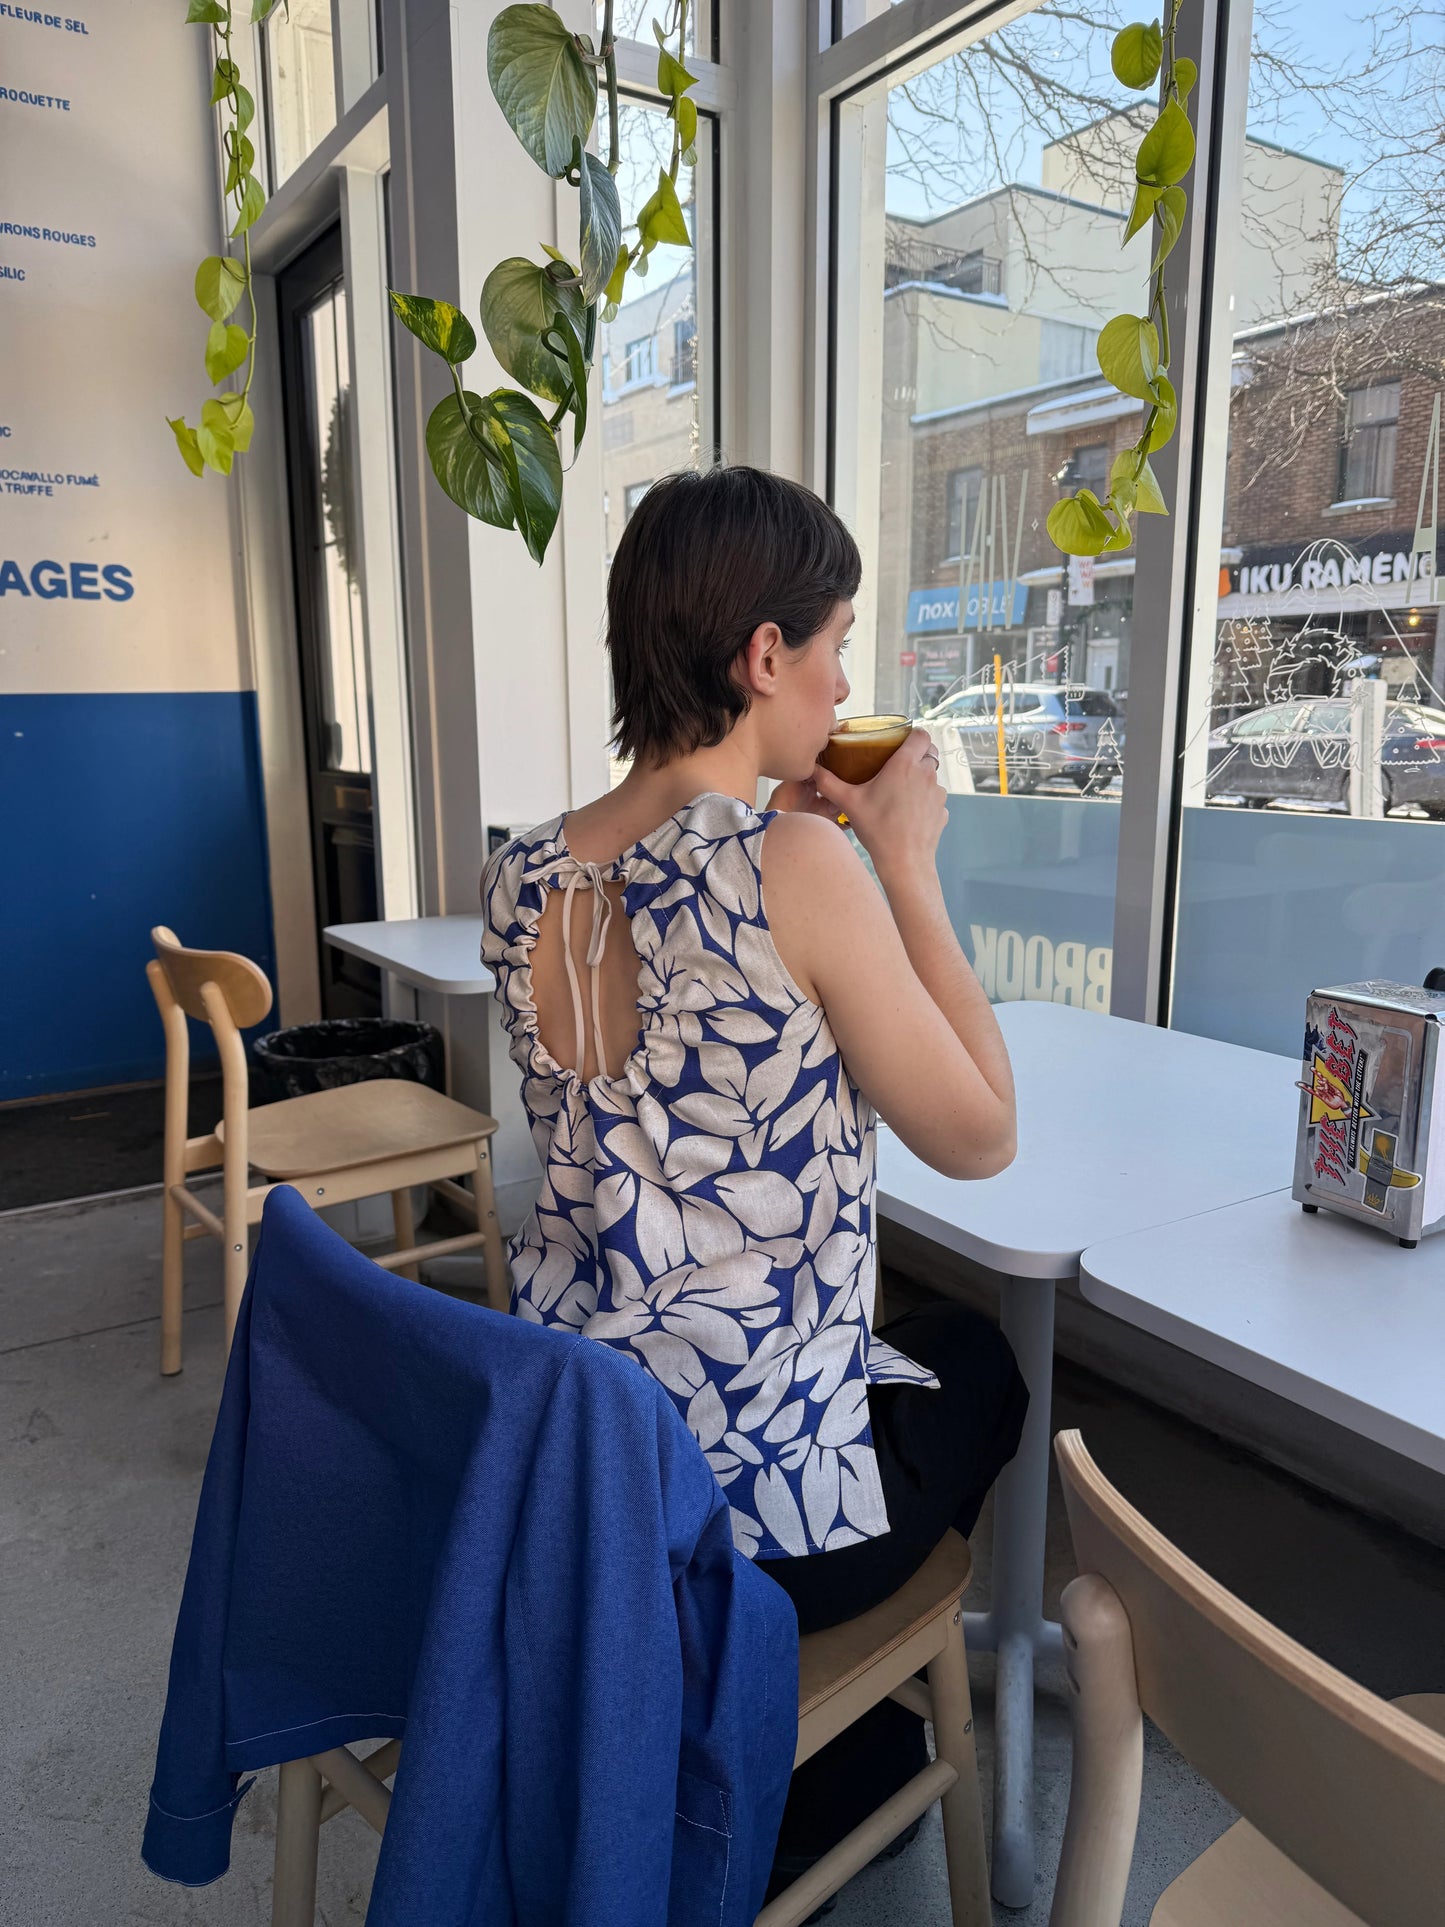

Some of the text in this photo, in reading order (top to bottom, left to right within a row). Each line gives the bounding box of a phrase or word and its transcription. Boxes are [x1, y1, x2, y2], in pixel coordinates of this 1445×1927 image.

[0, 3, 89, 35] FLEUR DE SEL
[0, 86, 71, 111] ROQUETTE
[42, 228, 97, 248] ROUGES
[5, 482, 54, 497] TRUFFE
[66, 474, 100, 487] FUMÉ
[1239, 551, 1418, 595] IKU RAMEN
